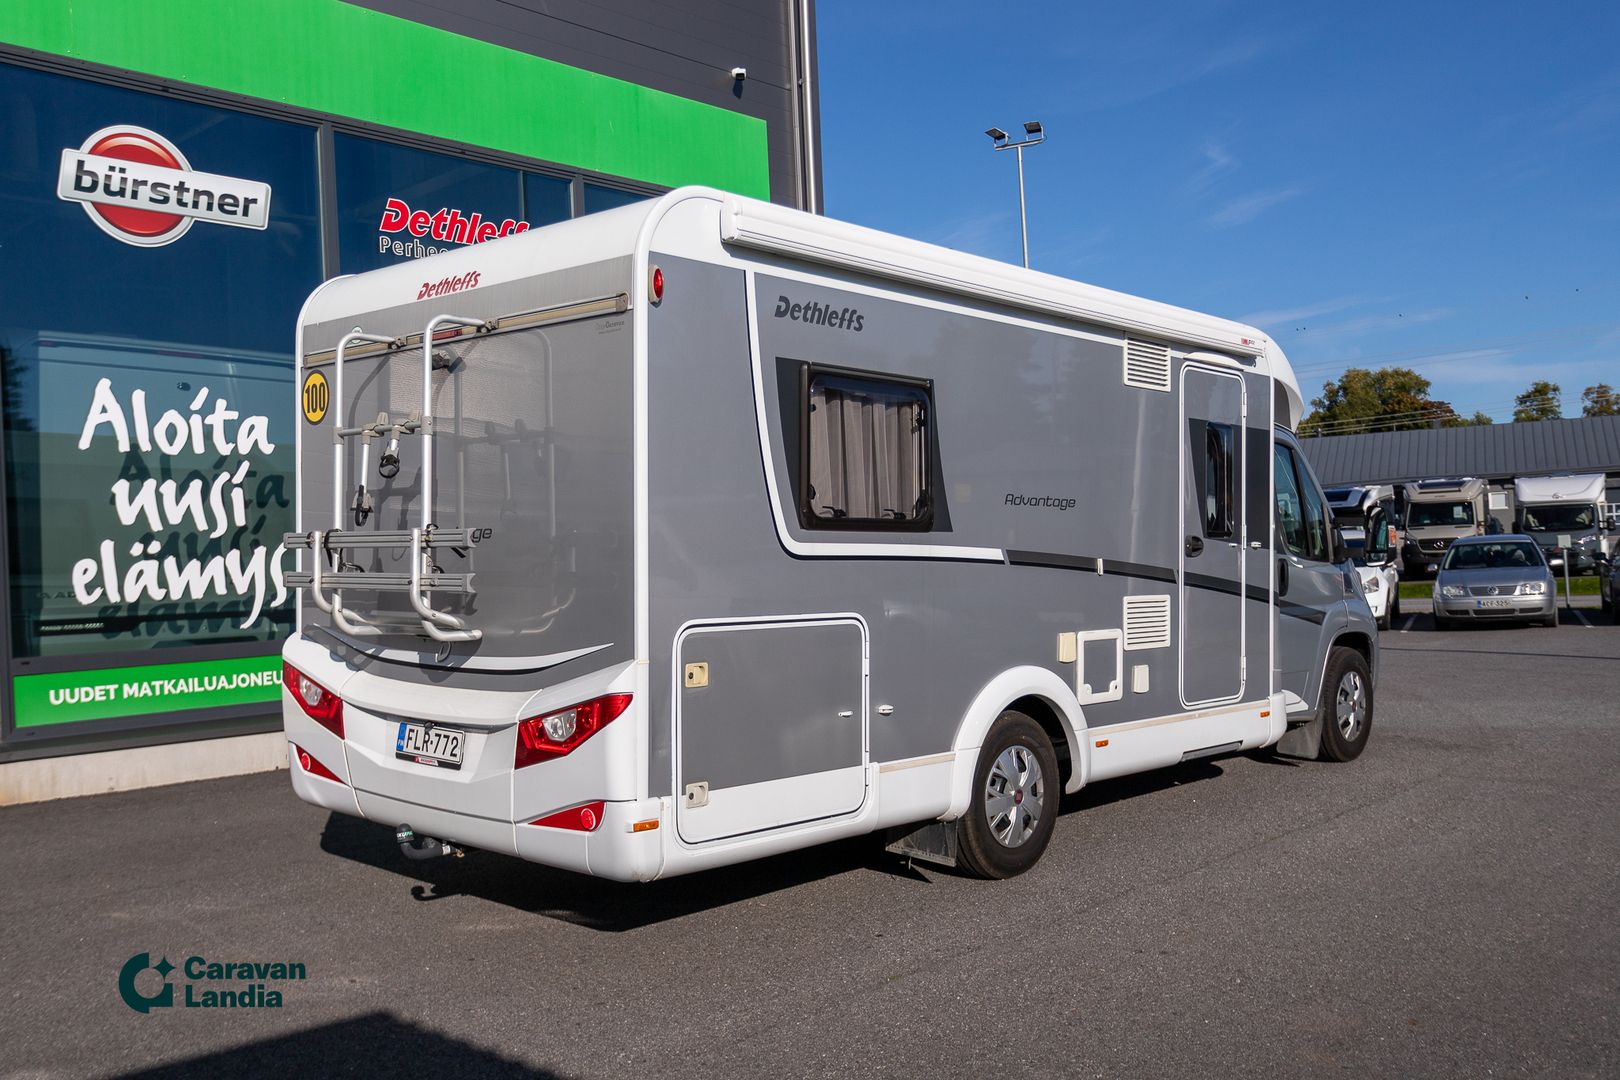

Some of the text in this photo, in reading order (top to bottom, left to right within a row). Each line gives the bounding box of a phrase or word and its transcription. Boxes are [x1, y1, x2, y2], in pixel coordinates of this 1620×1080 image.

[73, 159, 258, 218] bürstner
[416, 270, 482, 300] Dethleffs
[774, 295, 865, 332] Dethleffs
[305, 382, 326, 413] 100
[1004, 493, 1076, 511] Advantage
[72, 539, 288, 630] elämys
[49, 683, 119, 706] UUDET
[405, 727, 459, 758] FLR-772
